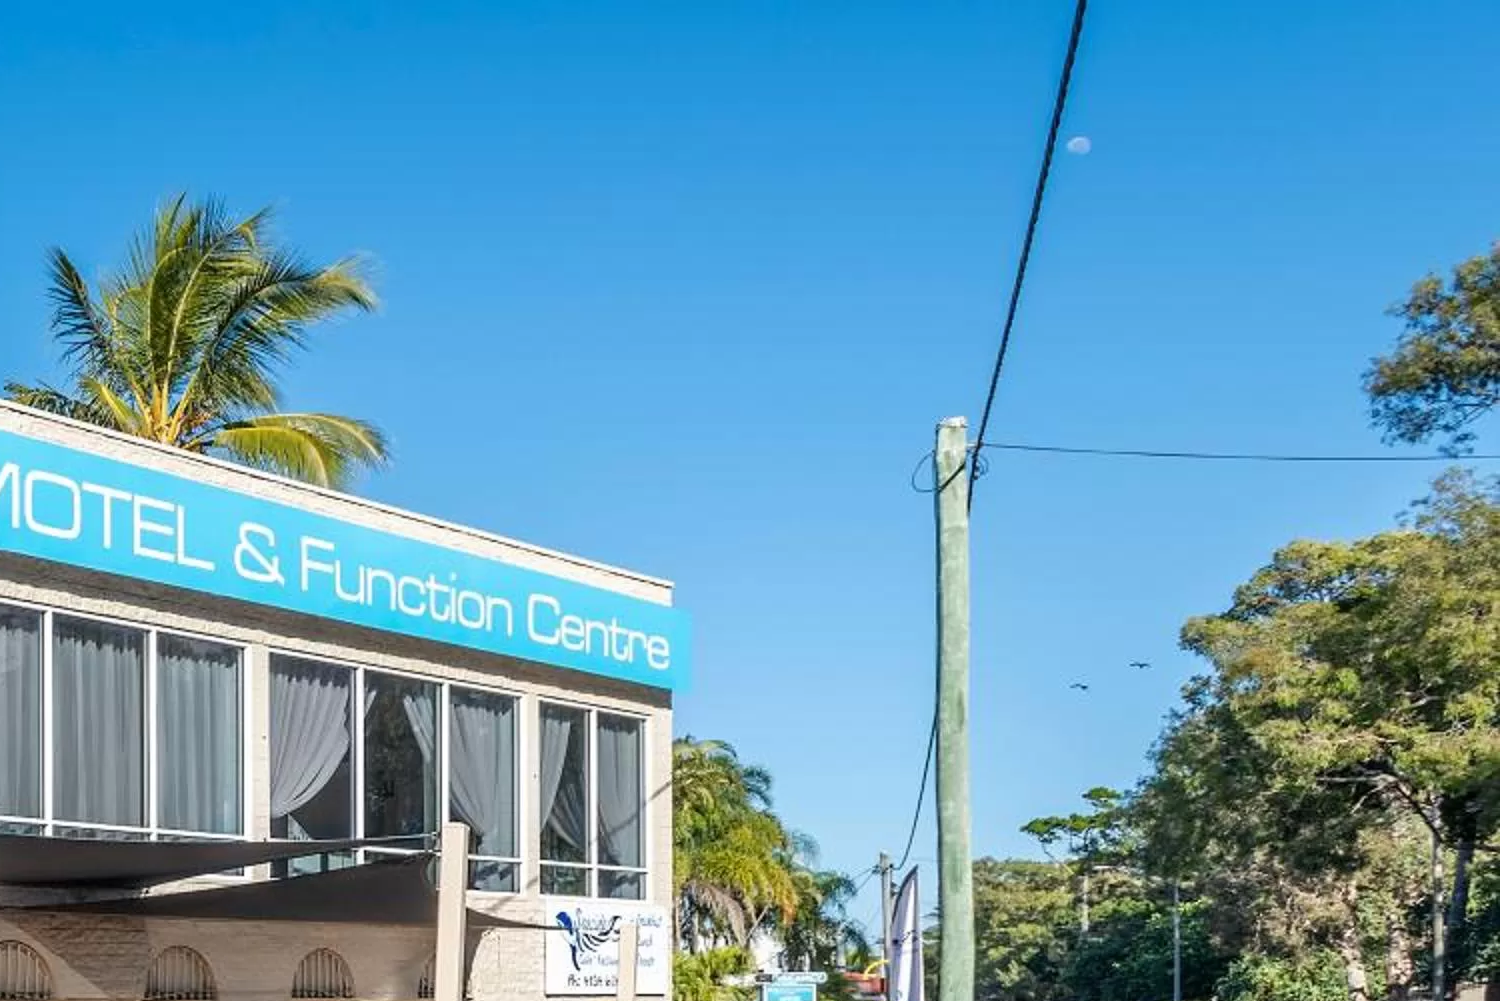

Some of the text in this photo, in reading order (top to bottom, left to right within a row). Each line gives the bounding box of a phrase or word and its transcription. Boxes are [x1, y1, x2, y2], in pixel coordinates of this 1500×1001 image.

[233, 521, 285, 588] &
[300, 535, 514, 637] Function
[527, 593, 670, 670] Centre
